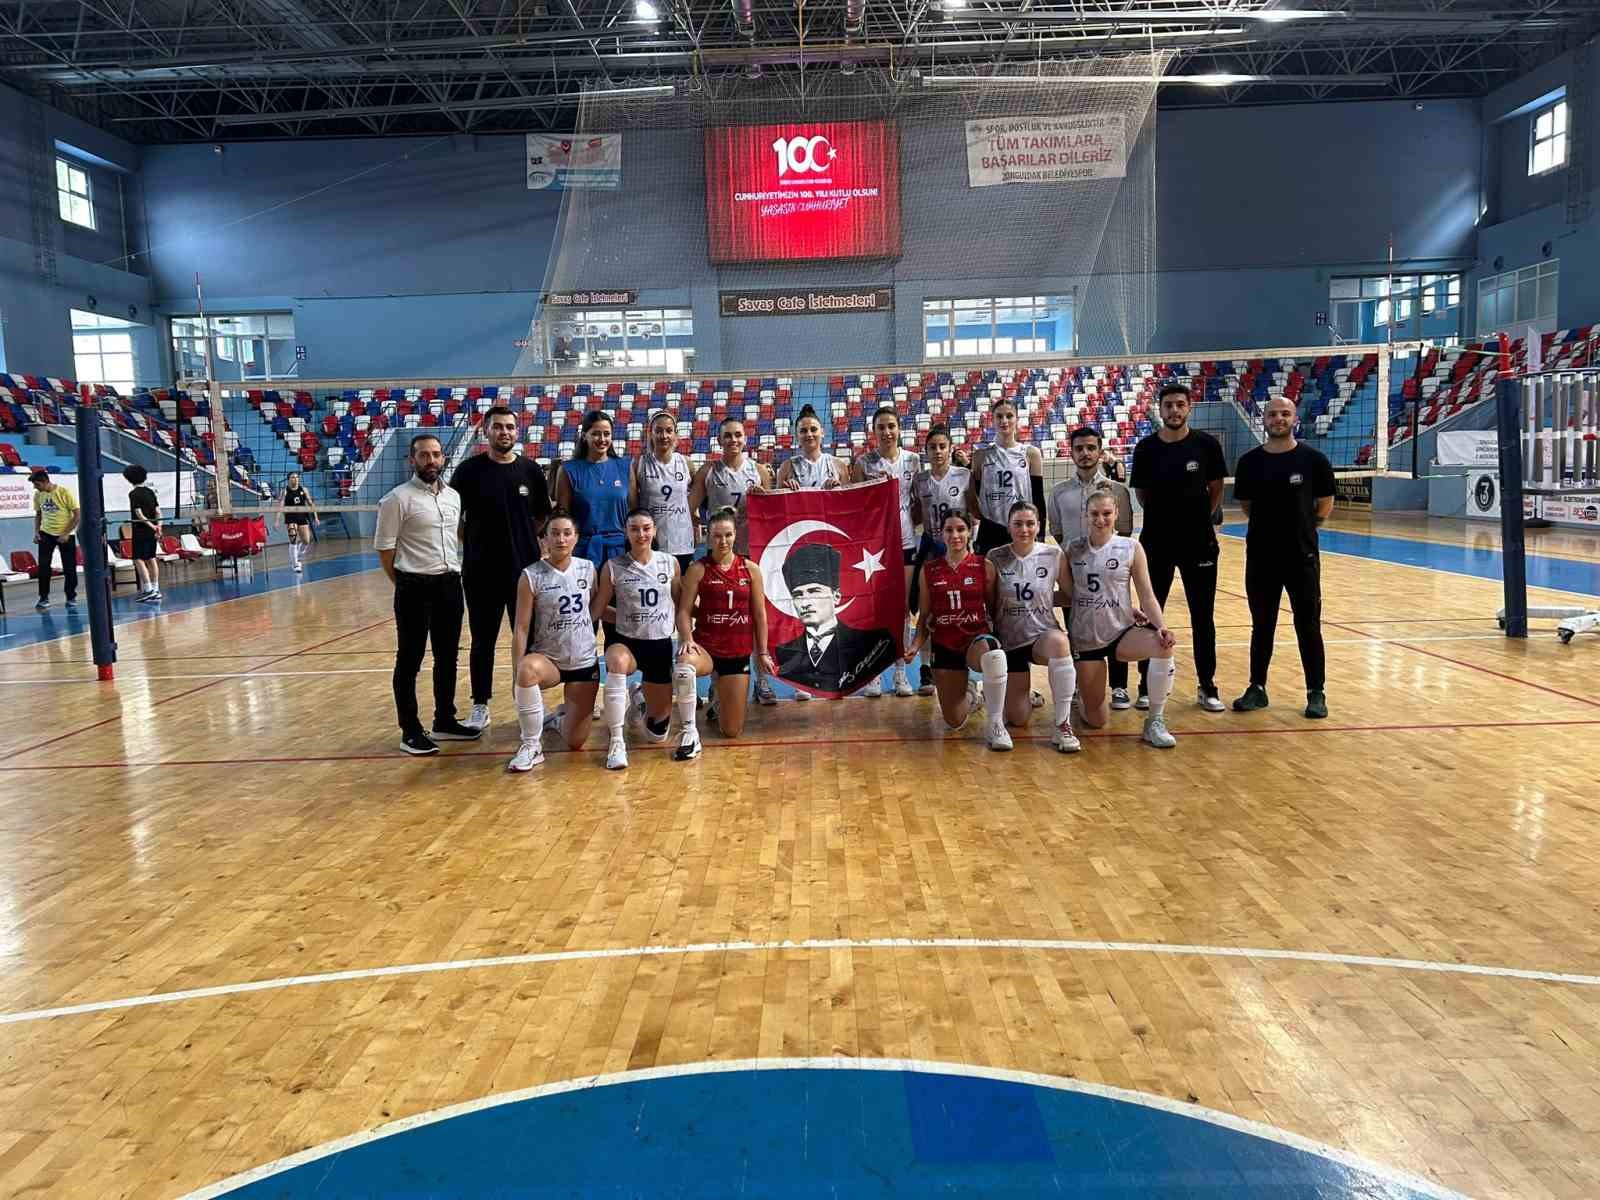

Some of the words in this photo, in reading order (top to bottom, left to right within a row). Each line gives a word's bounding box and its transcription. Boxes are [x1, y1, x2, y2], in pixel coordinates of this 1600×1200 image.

[988, 133, 1019, 151] TÜM
[1021, 133, 1104, 149] TAKIMLARA
[981, 152, 1057, 170] BAŞARILAR
[1059, 148, 1112, 165] DİLERİZ
[829, 188, 851, 198] KUTLU
[852, 187, 878, 197] OLSUN!
[776, 296, 806, 310] Cafe
[997, 470, 1013, 488] 12
[661, 485, 673, 502] 9
[730, 492, 742, 507] 7
[1014, 582, 1034, 602] 16
[1087, 573, 1100, 593] 5
[558, 593, 584, 615] 23
[638, 588, 659, 608] 10
[727, 590, 734, 610] 1
[947, 590, 962, 610] 11
